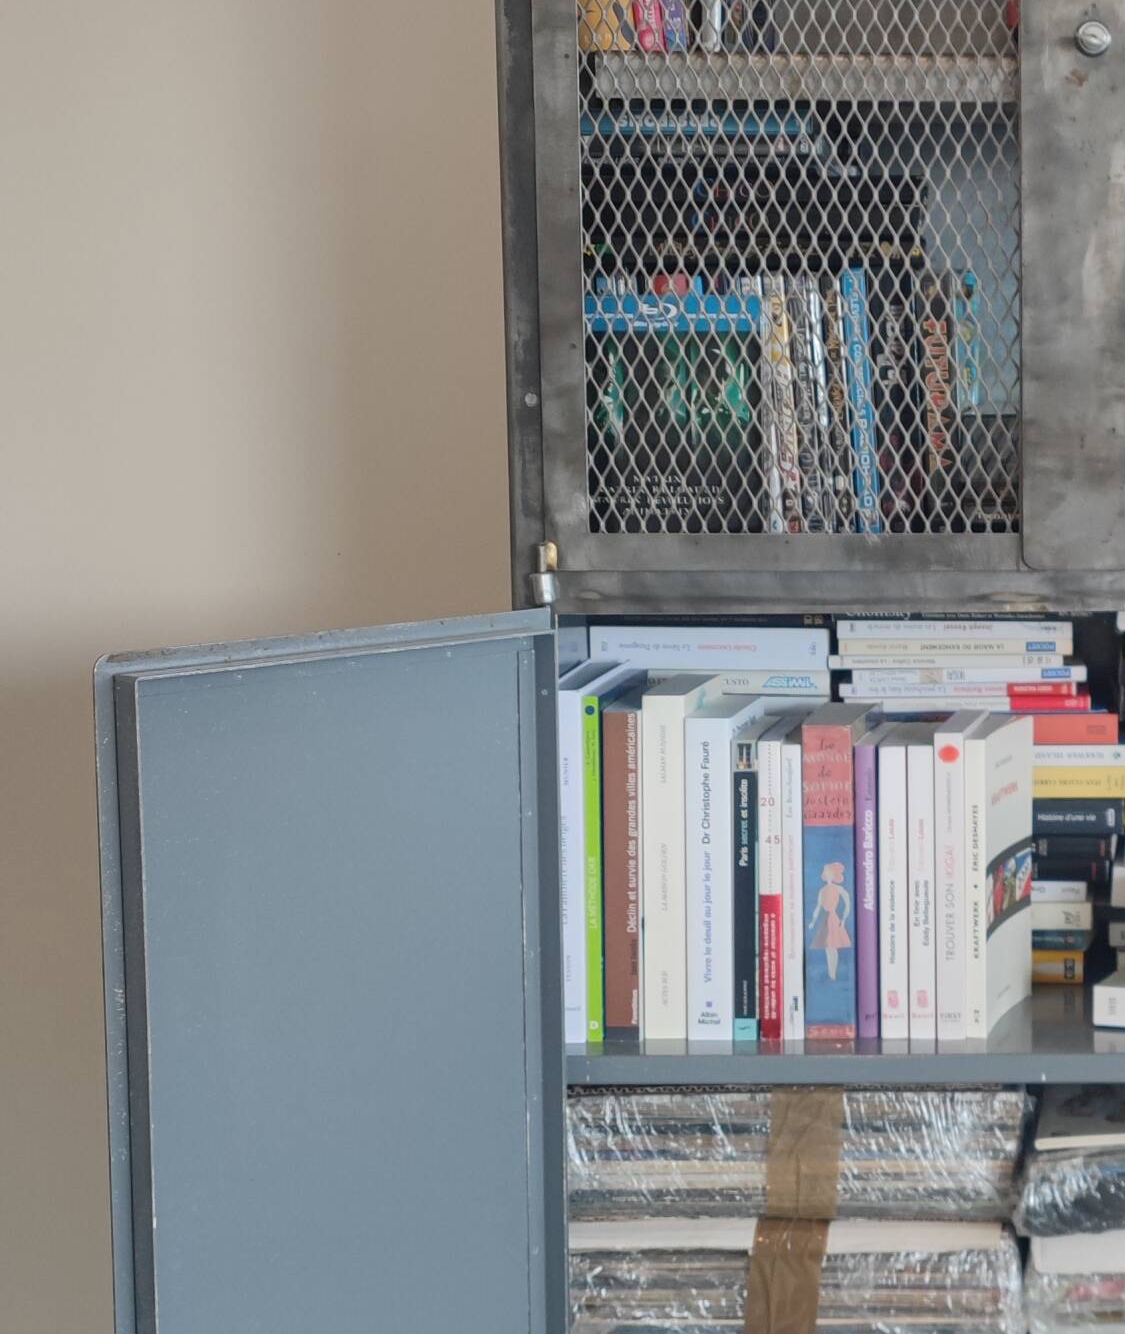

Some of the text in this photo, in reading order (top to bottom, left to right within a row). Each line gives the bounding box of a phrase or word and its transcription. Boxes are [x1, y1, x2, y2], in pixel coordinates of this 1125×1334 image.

[923, 318, 953, 474] FUTURAMA
[625, 713, 636, 770] américaines
[818, 738, 835, 750] Le
[818, 765, 833, 778] de
[626, 772, 636, 797] villes
[803, 780, 852, 793] SOPHIE
[760, 798, 776, 807] 20
[806, 794, 849, 807] Jostein
[626, 800, 638, 837] grandes
[738, 778, 748, 867] Paris secret et insolite
[1037, 812, 1064, 822] Histoire
[1083, 813, 1097, 822] vie
[971, 805, 979, 850] DESHAYES
[626, 840, 636, 857] des
[765, 835, 780, 844] 45
[700, 741, 713, 984] Vivre le deuil au jour le jour Dr Christophe Fauré
[862, 810, 874, 911] Alessandro Baricco
[627, 859, 637, 888] survie
[628, 891, 637, 900] et
[944, 883, 955, 909] SON
[626, 902, 638, 933] Déclin
[889, 913, 895, 921] la
[913, 916, 920, 928] En
[889, 923, 895, 933] de
[922, 927, 931, 947] Eddy
[944, 913, 956, 962] TROUVER
